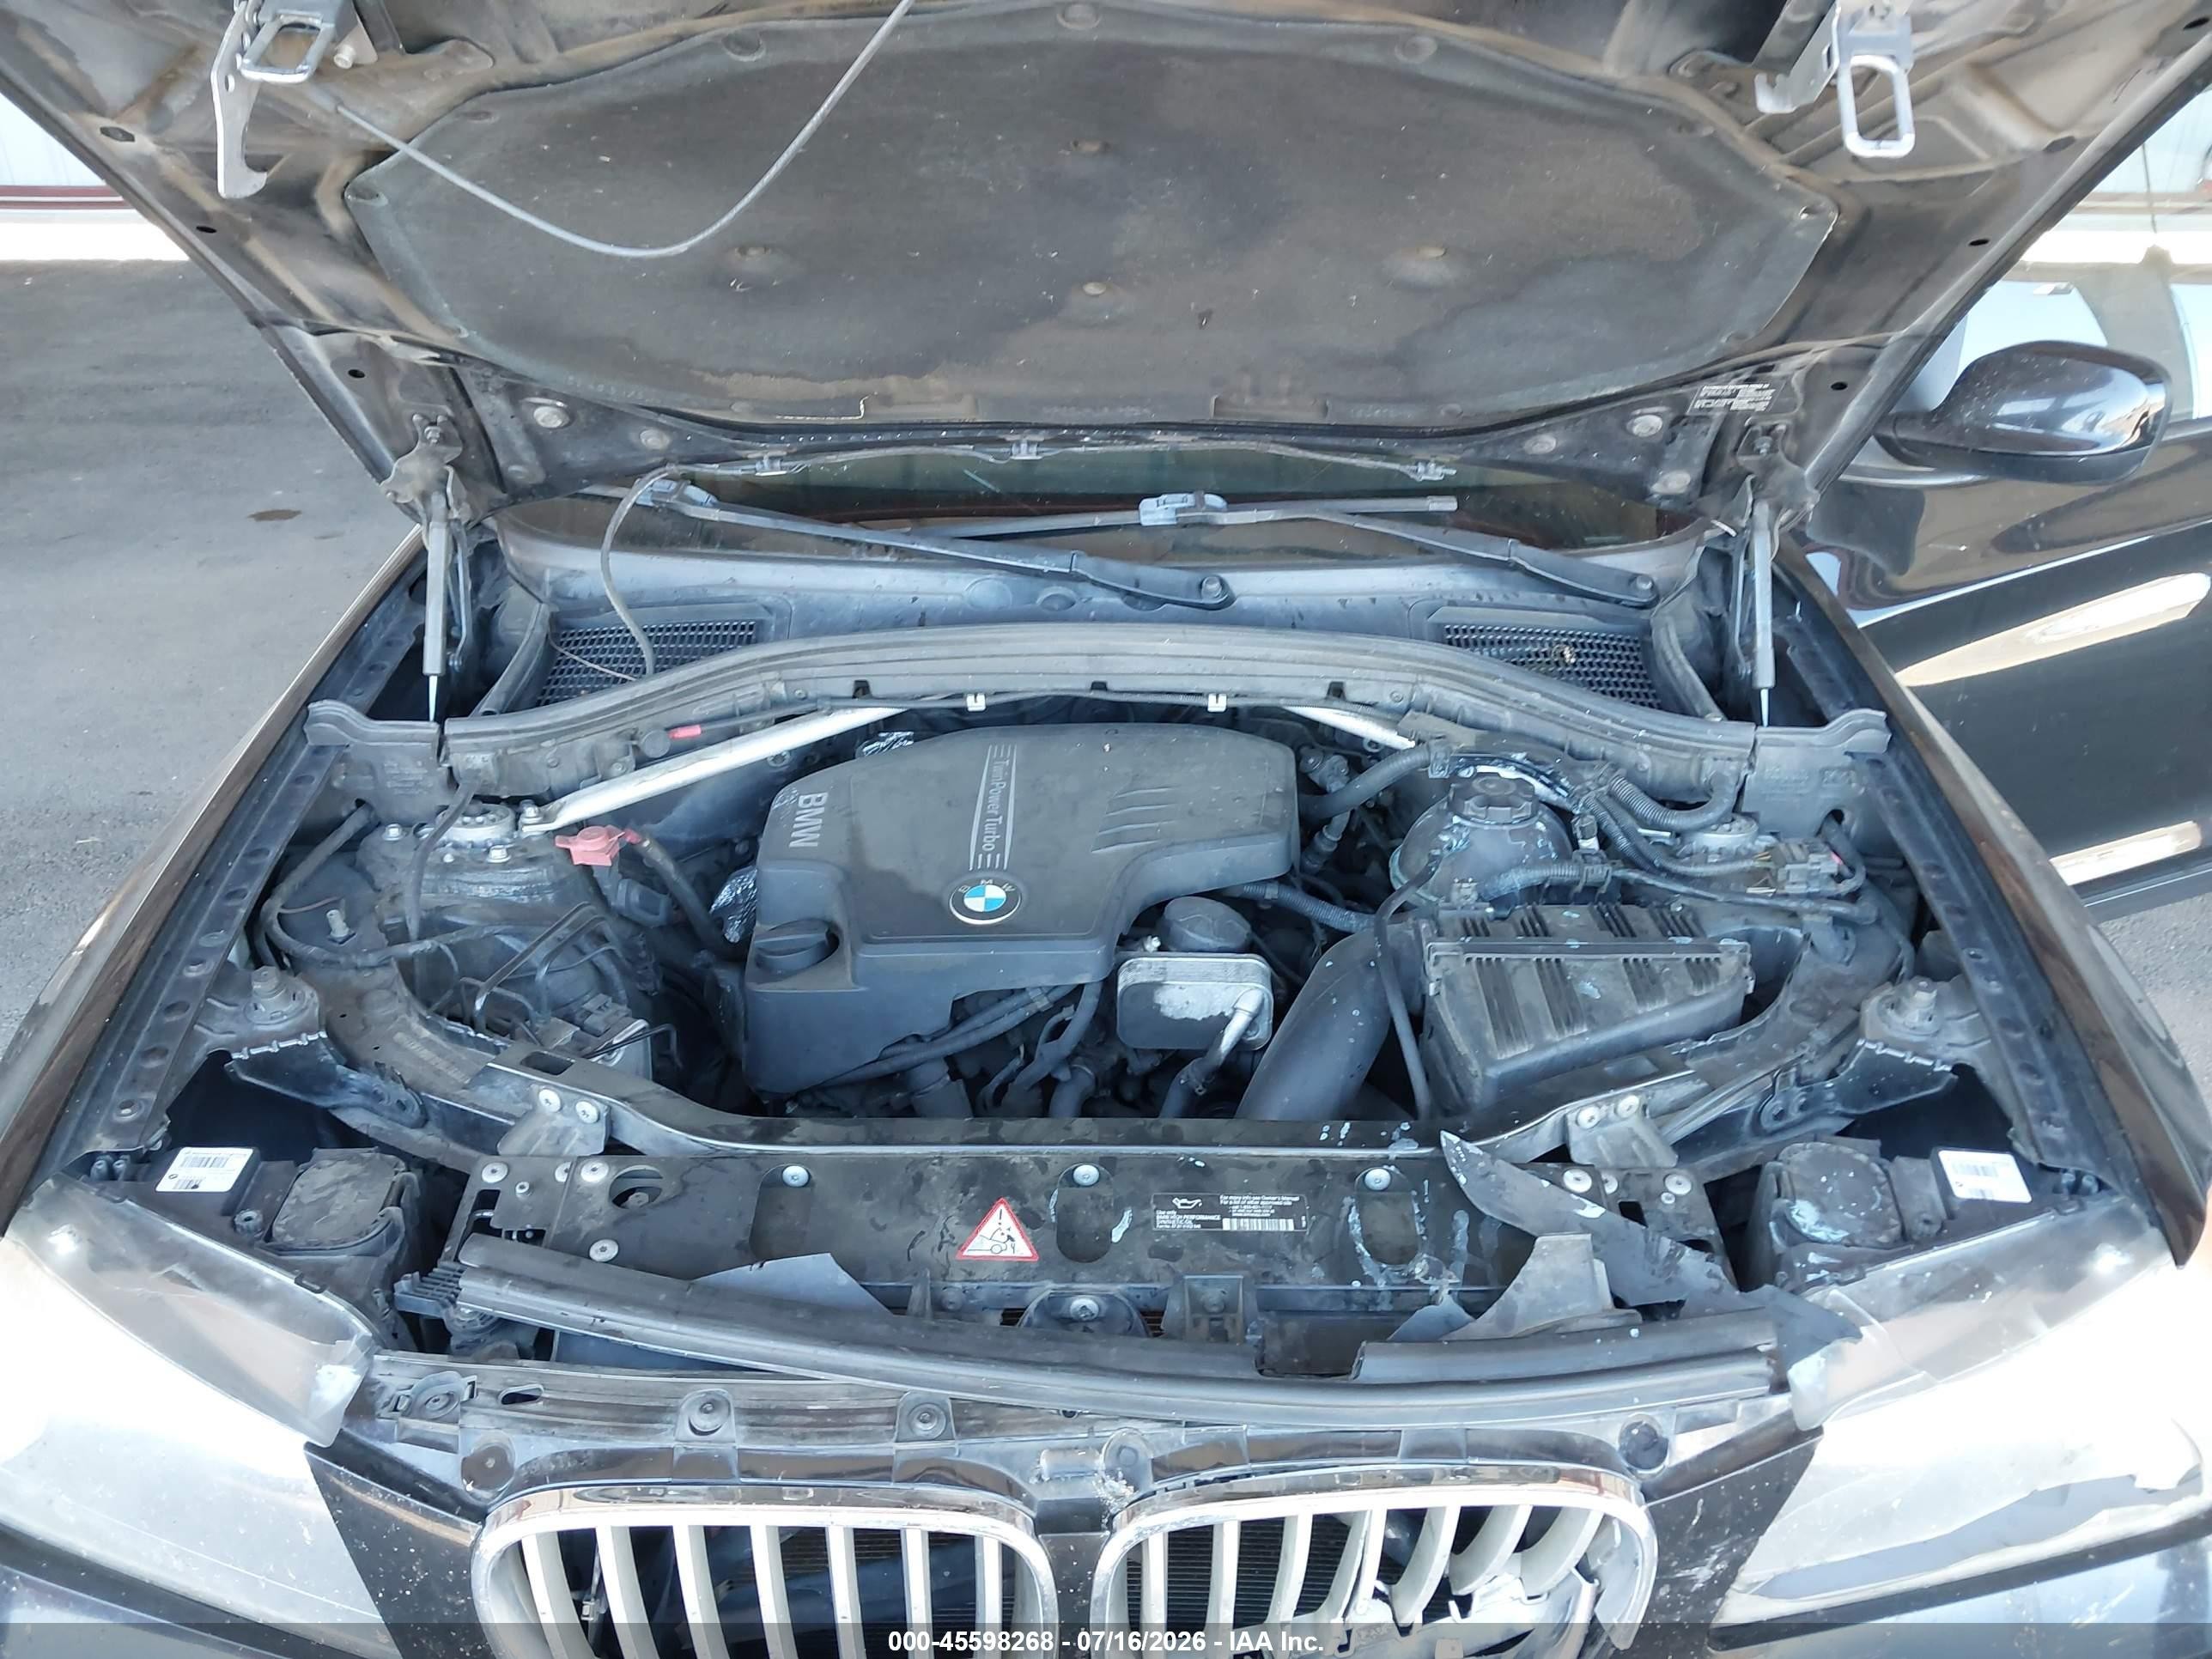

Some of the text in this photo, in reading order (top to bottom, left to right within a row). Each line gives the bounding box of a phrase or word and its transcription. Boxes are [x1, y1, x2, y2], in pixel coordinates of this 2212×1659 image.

[789, 792, 828, 848] BMW
[981, 759, 1010, 852] TwinPower Turbo
[957, 878, 1017, 893] BMW
